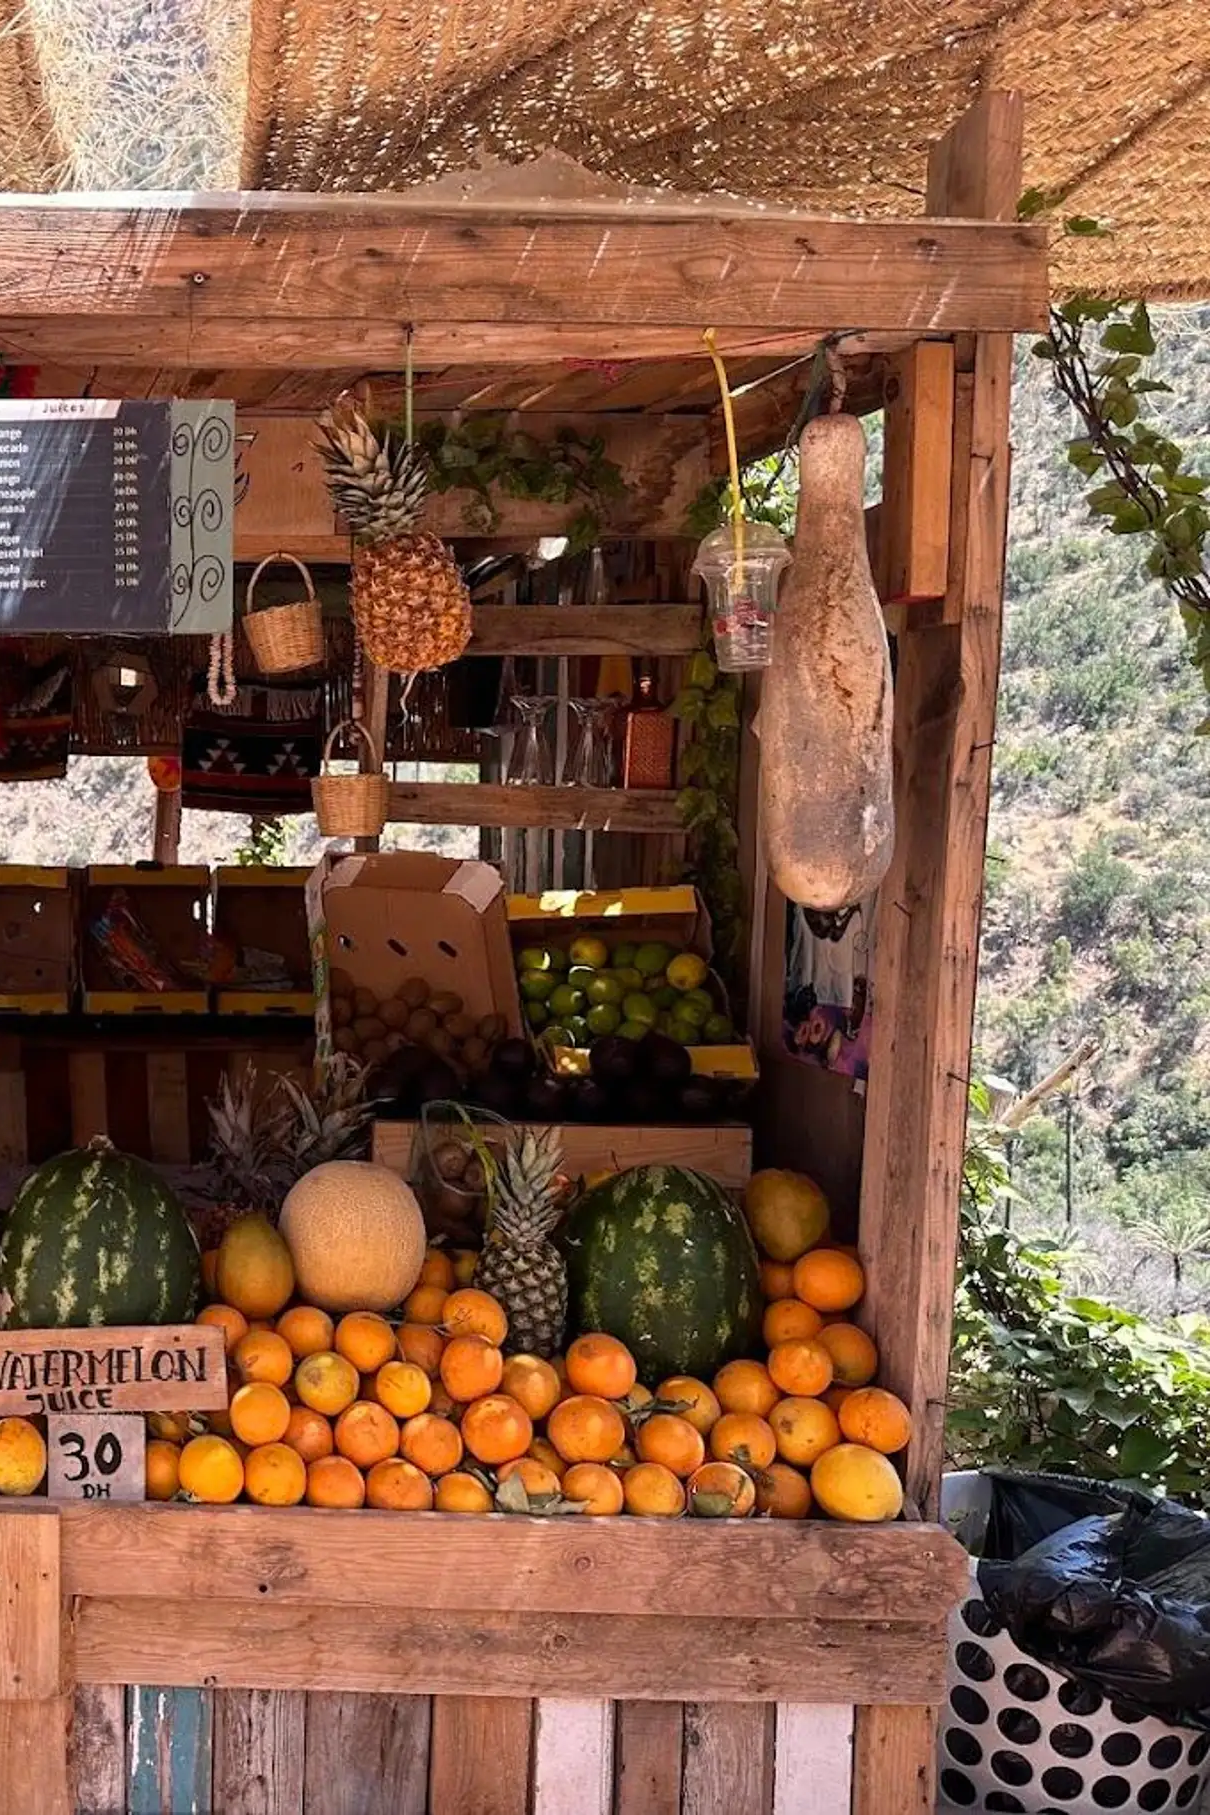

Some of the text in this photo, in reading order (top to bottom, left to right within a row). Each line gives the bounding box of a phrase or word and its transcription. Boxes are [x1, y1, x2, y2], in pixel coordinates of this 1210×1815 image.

[23, 546, 44, 558] fruit
[26, 1389, 113, 1414] JUICE
[58, 1432, 122, 1481] 30
[81, 1483, 111, 1499] DH
